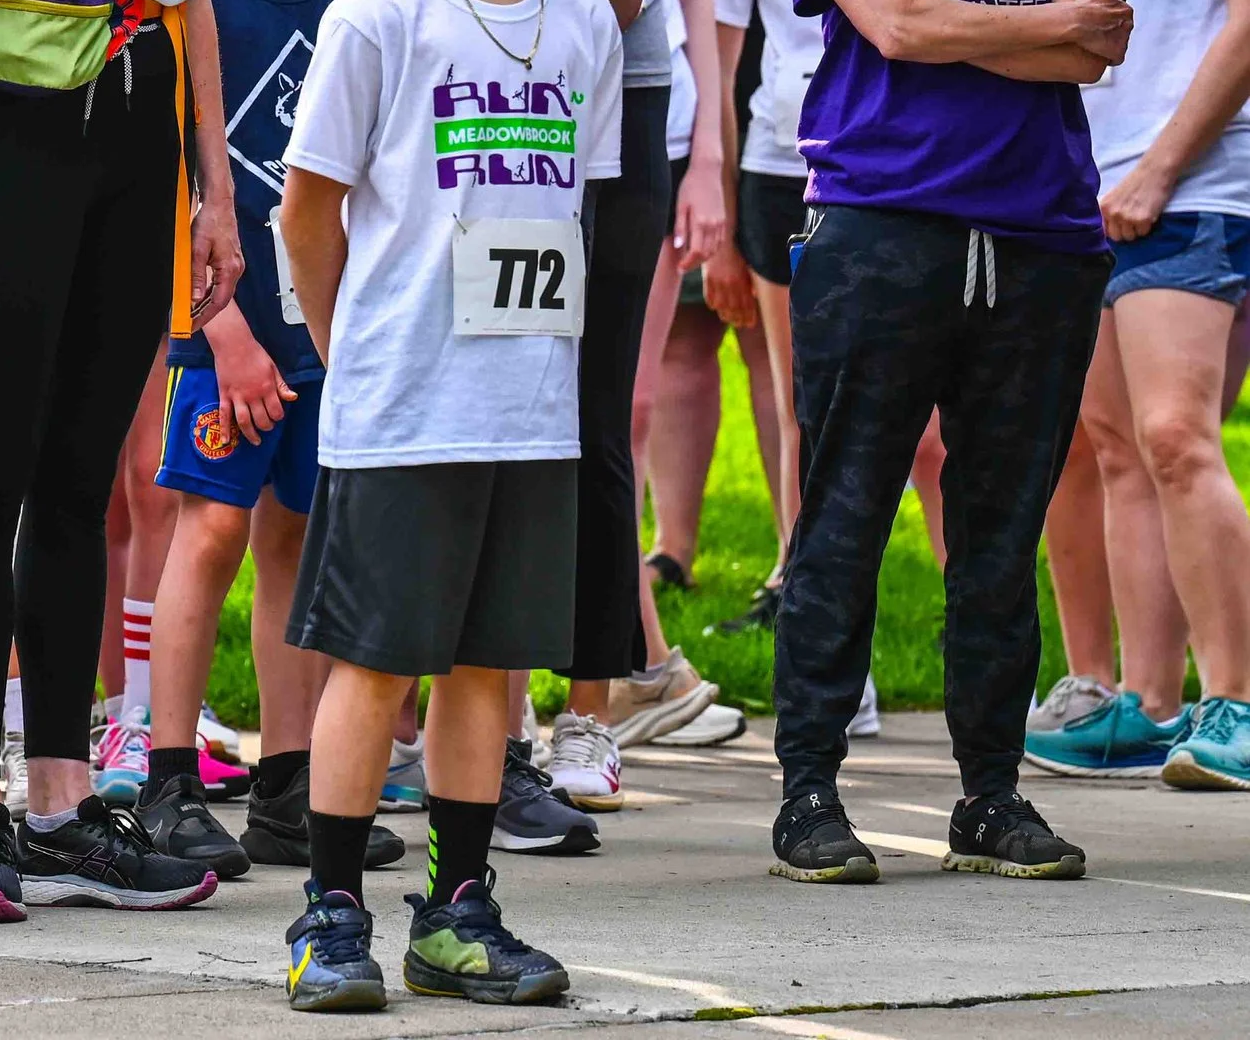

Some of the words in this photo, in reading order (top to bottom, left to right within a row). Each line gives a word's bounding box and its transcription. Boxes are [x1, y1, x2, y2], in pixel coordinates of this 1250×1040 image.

[433, 81, 572, 118] RUN
[448, 125, 571, 145] MEADOWBROOK
[436, 153, 575, 189] RUN
[489, 248, 566, 310] 772
